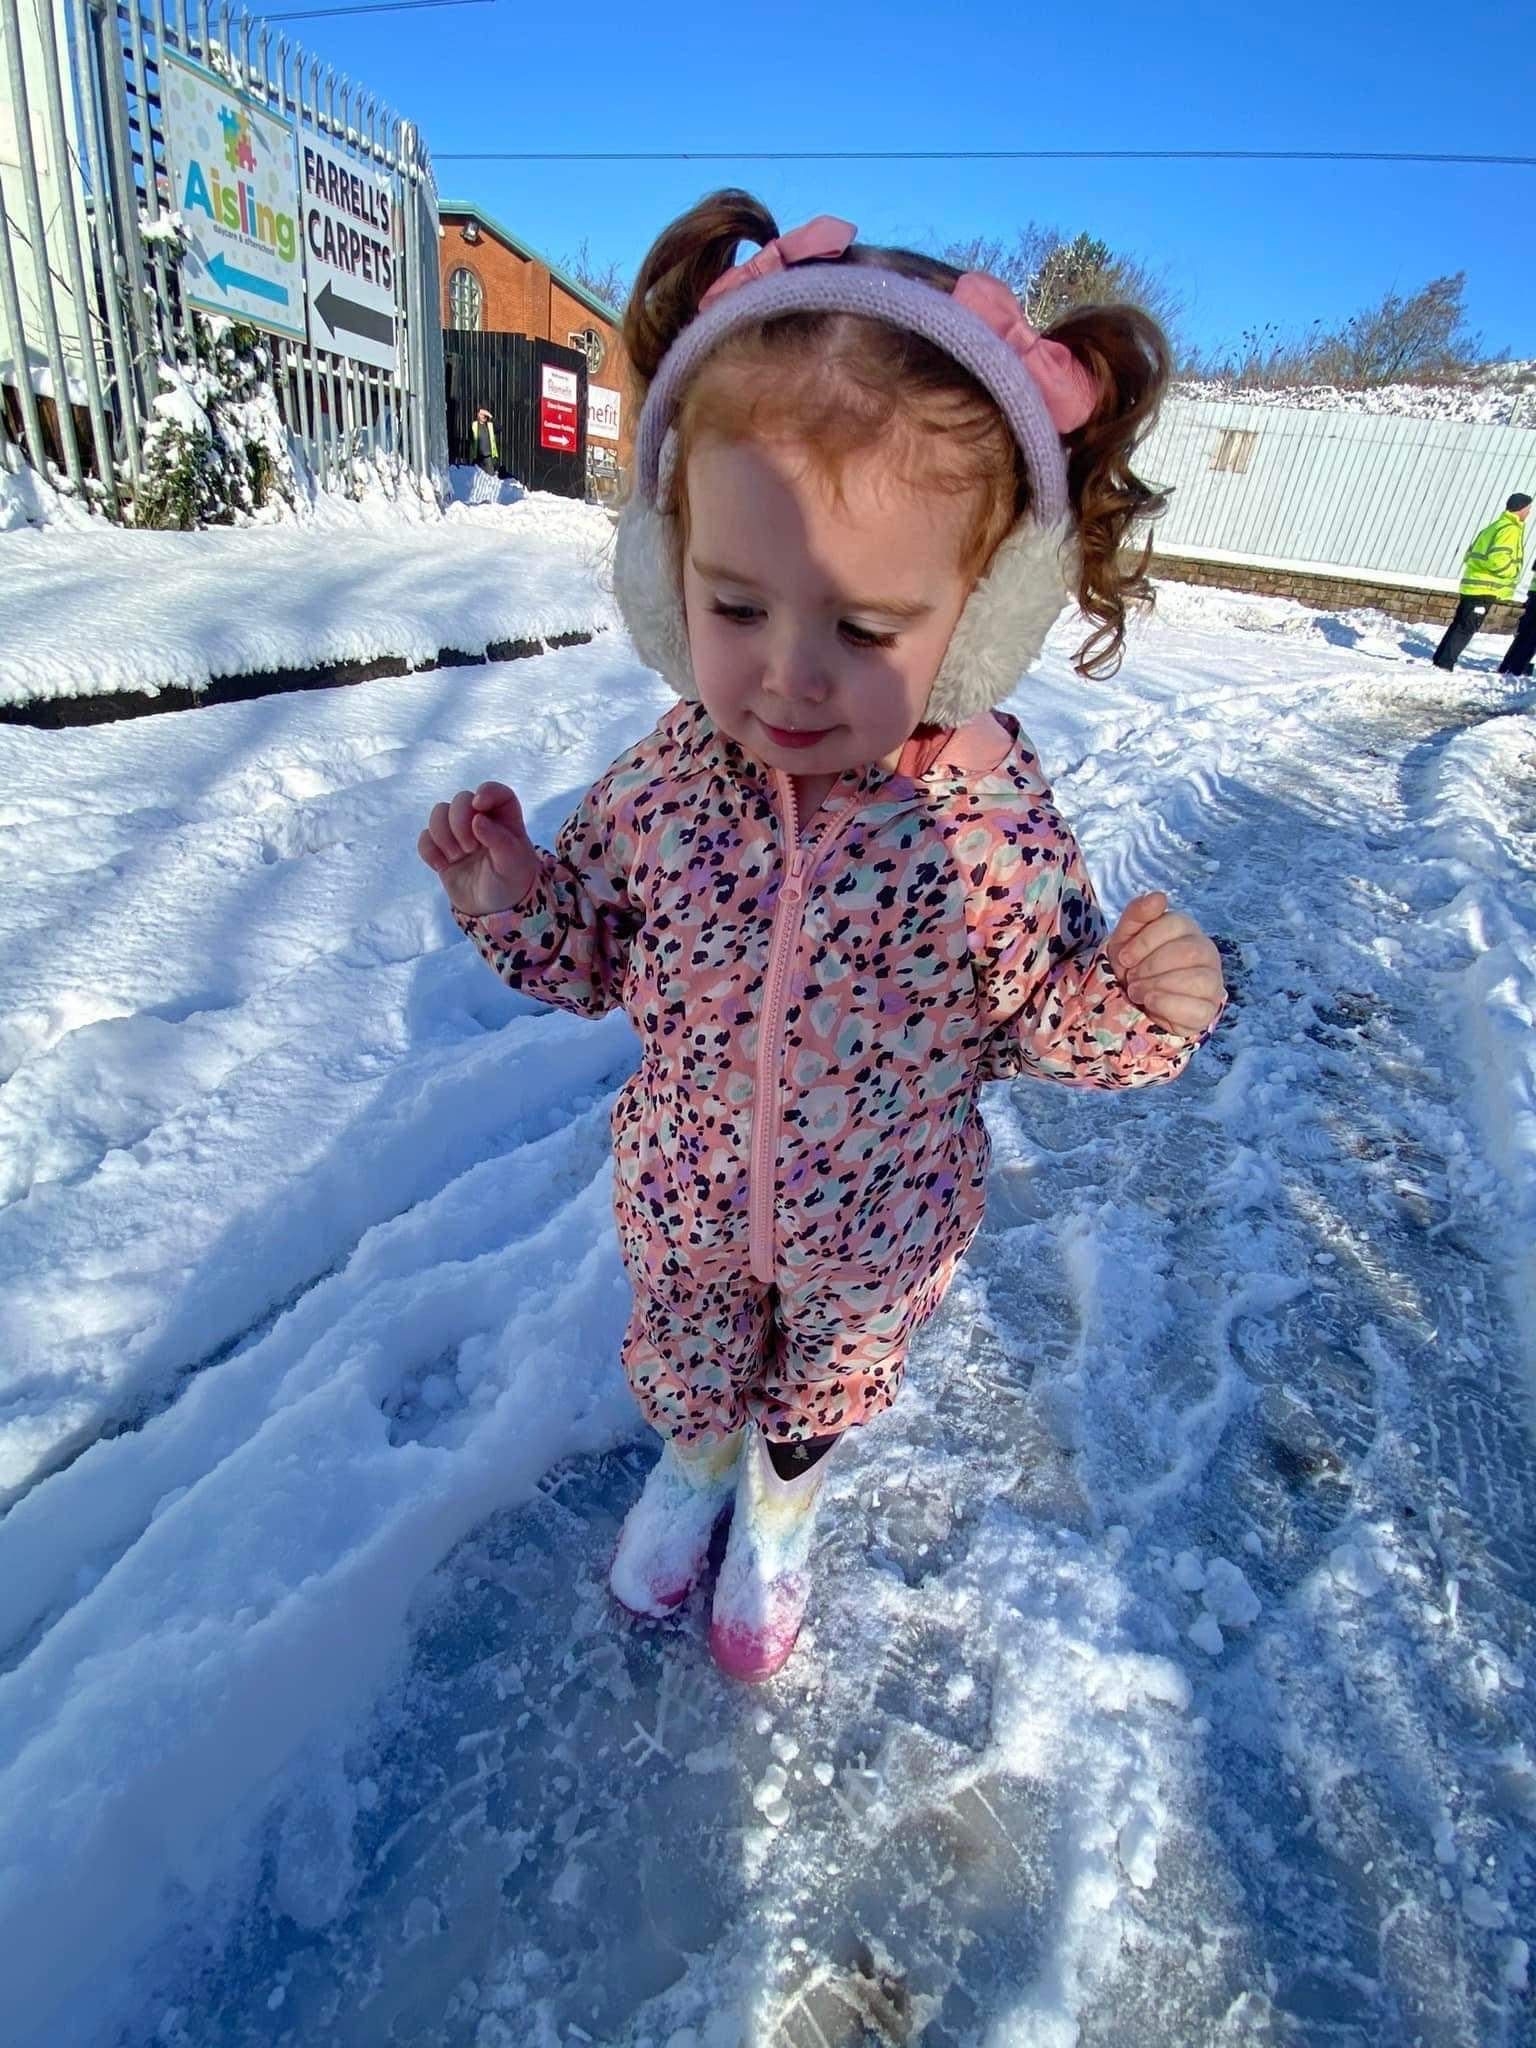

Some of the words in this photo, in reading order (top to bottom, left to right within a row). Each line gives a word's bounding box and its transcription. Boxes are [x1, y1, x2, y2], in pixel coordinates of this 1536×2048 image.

[184, 159, 296, 262] Aisling
[304, 146, 390, 235] FARRELL'S
[307, 208, 392, 291] CARPETS
